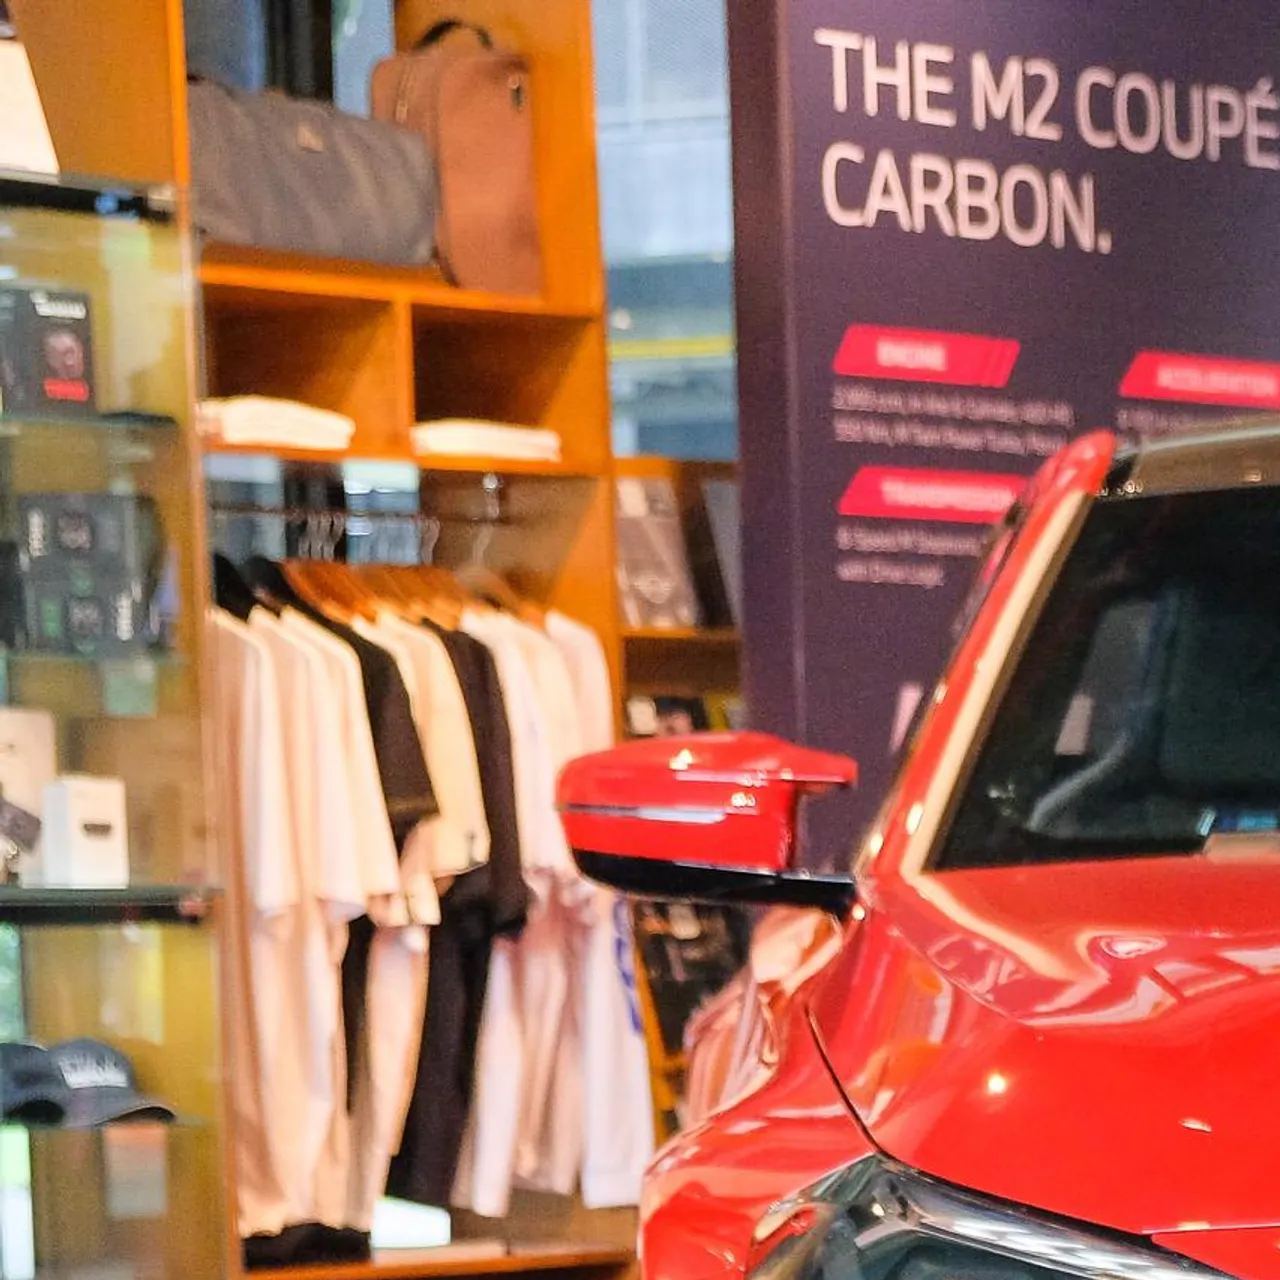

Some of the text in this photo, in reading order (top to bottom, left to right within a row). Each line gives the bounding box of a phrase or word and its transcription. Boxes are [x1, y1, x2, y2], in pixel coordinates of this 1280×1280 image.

[813, 27, 958, 128] THE
[970, 50, 1064, 142] M2
[821, 141, 1113, 255] CARBON.
